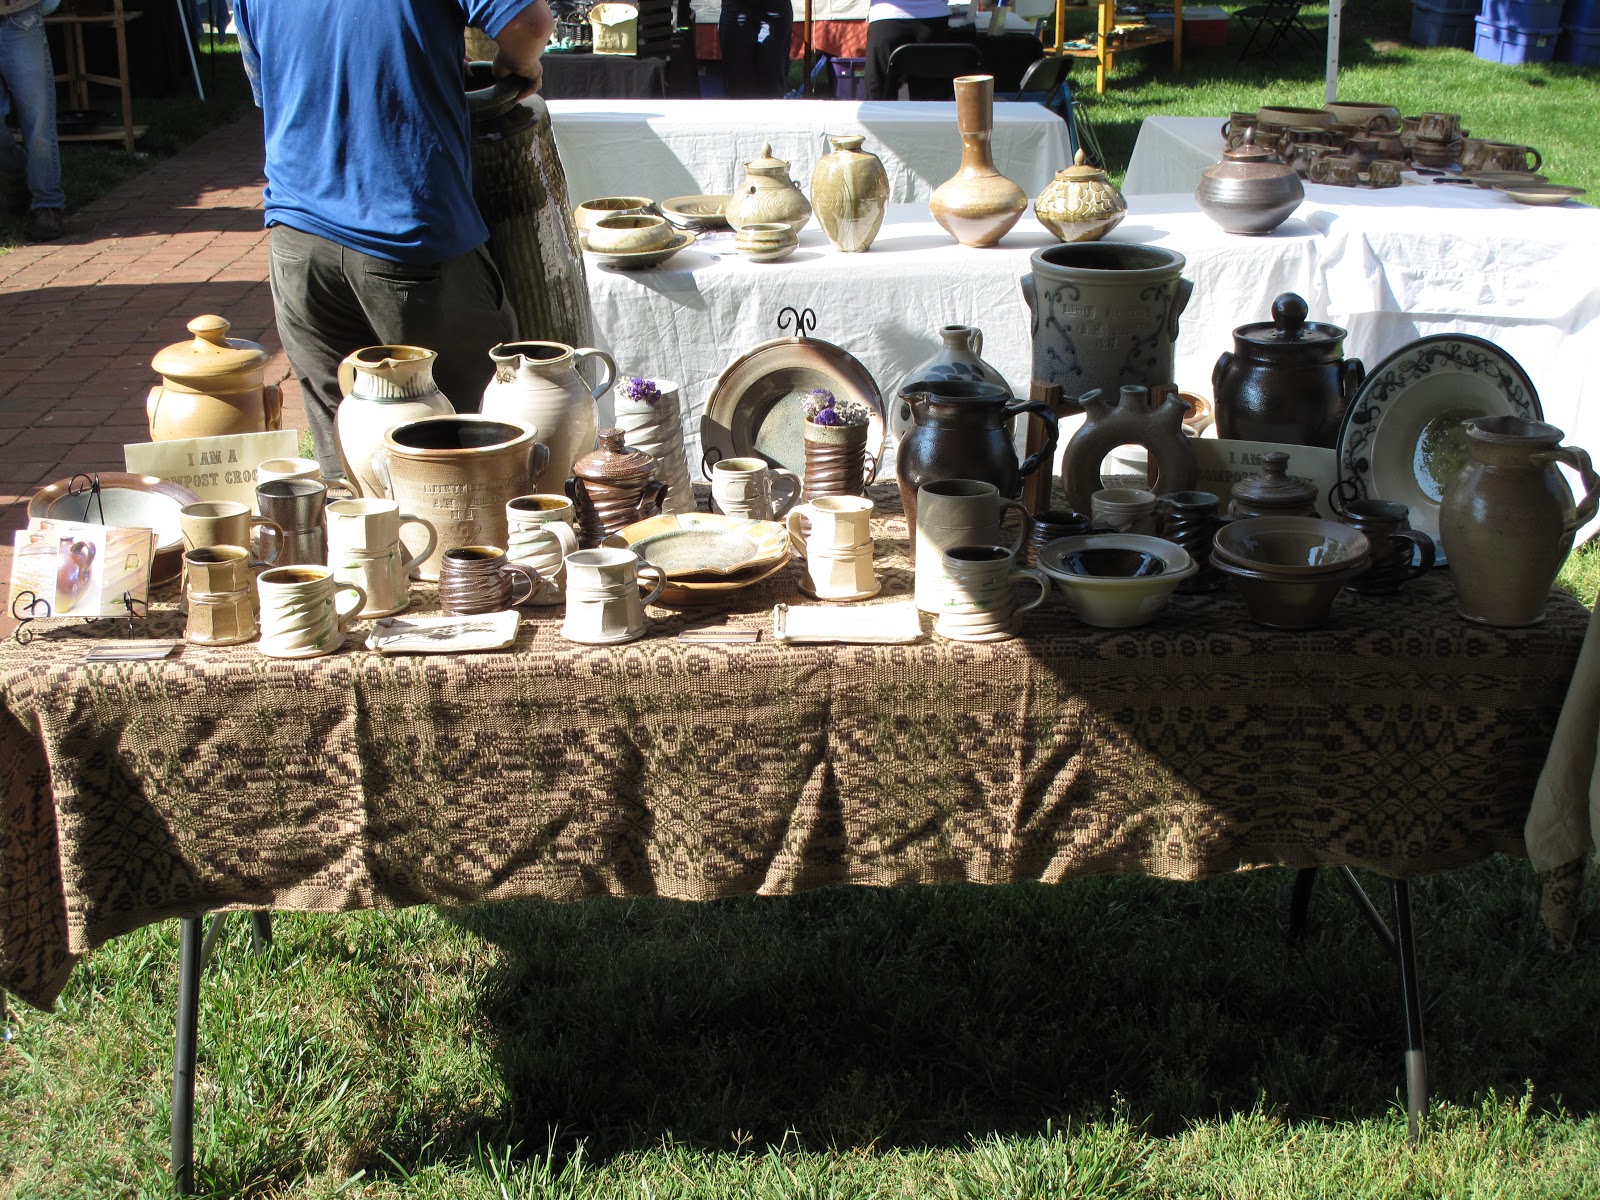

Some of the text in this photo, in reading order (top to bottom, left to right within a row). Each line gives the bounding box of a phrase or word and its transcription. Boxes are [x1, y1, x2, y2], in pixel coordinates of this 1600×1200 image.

[187, 449, 238, 467] I AM A
[1229, 451, 1237, 464] I
[163, 468, 258, 488] MPOST CROC
